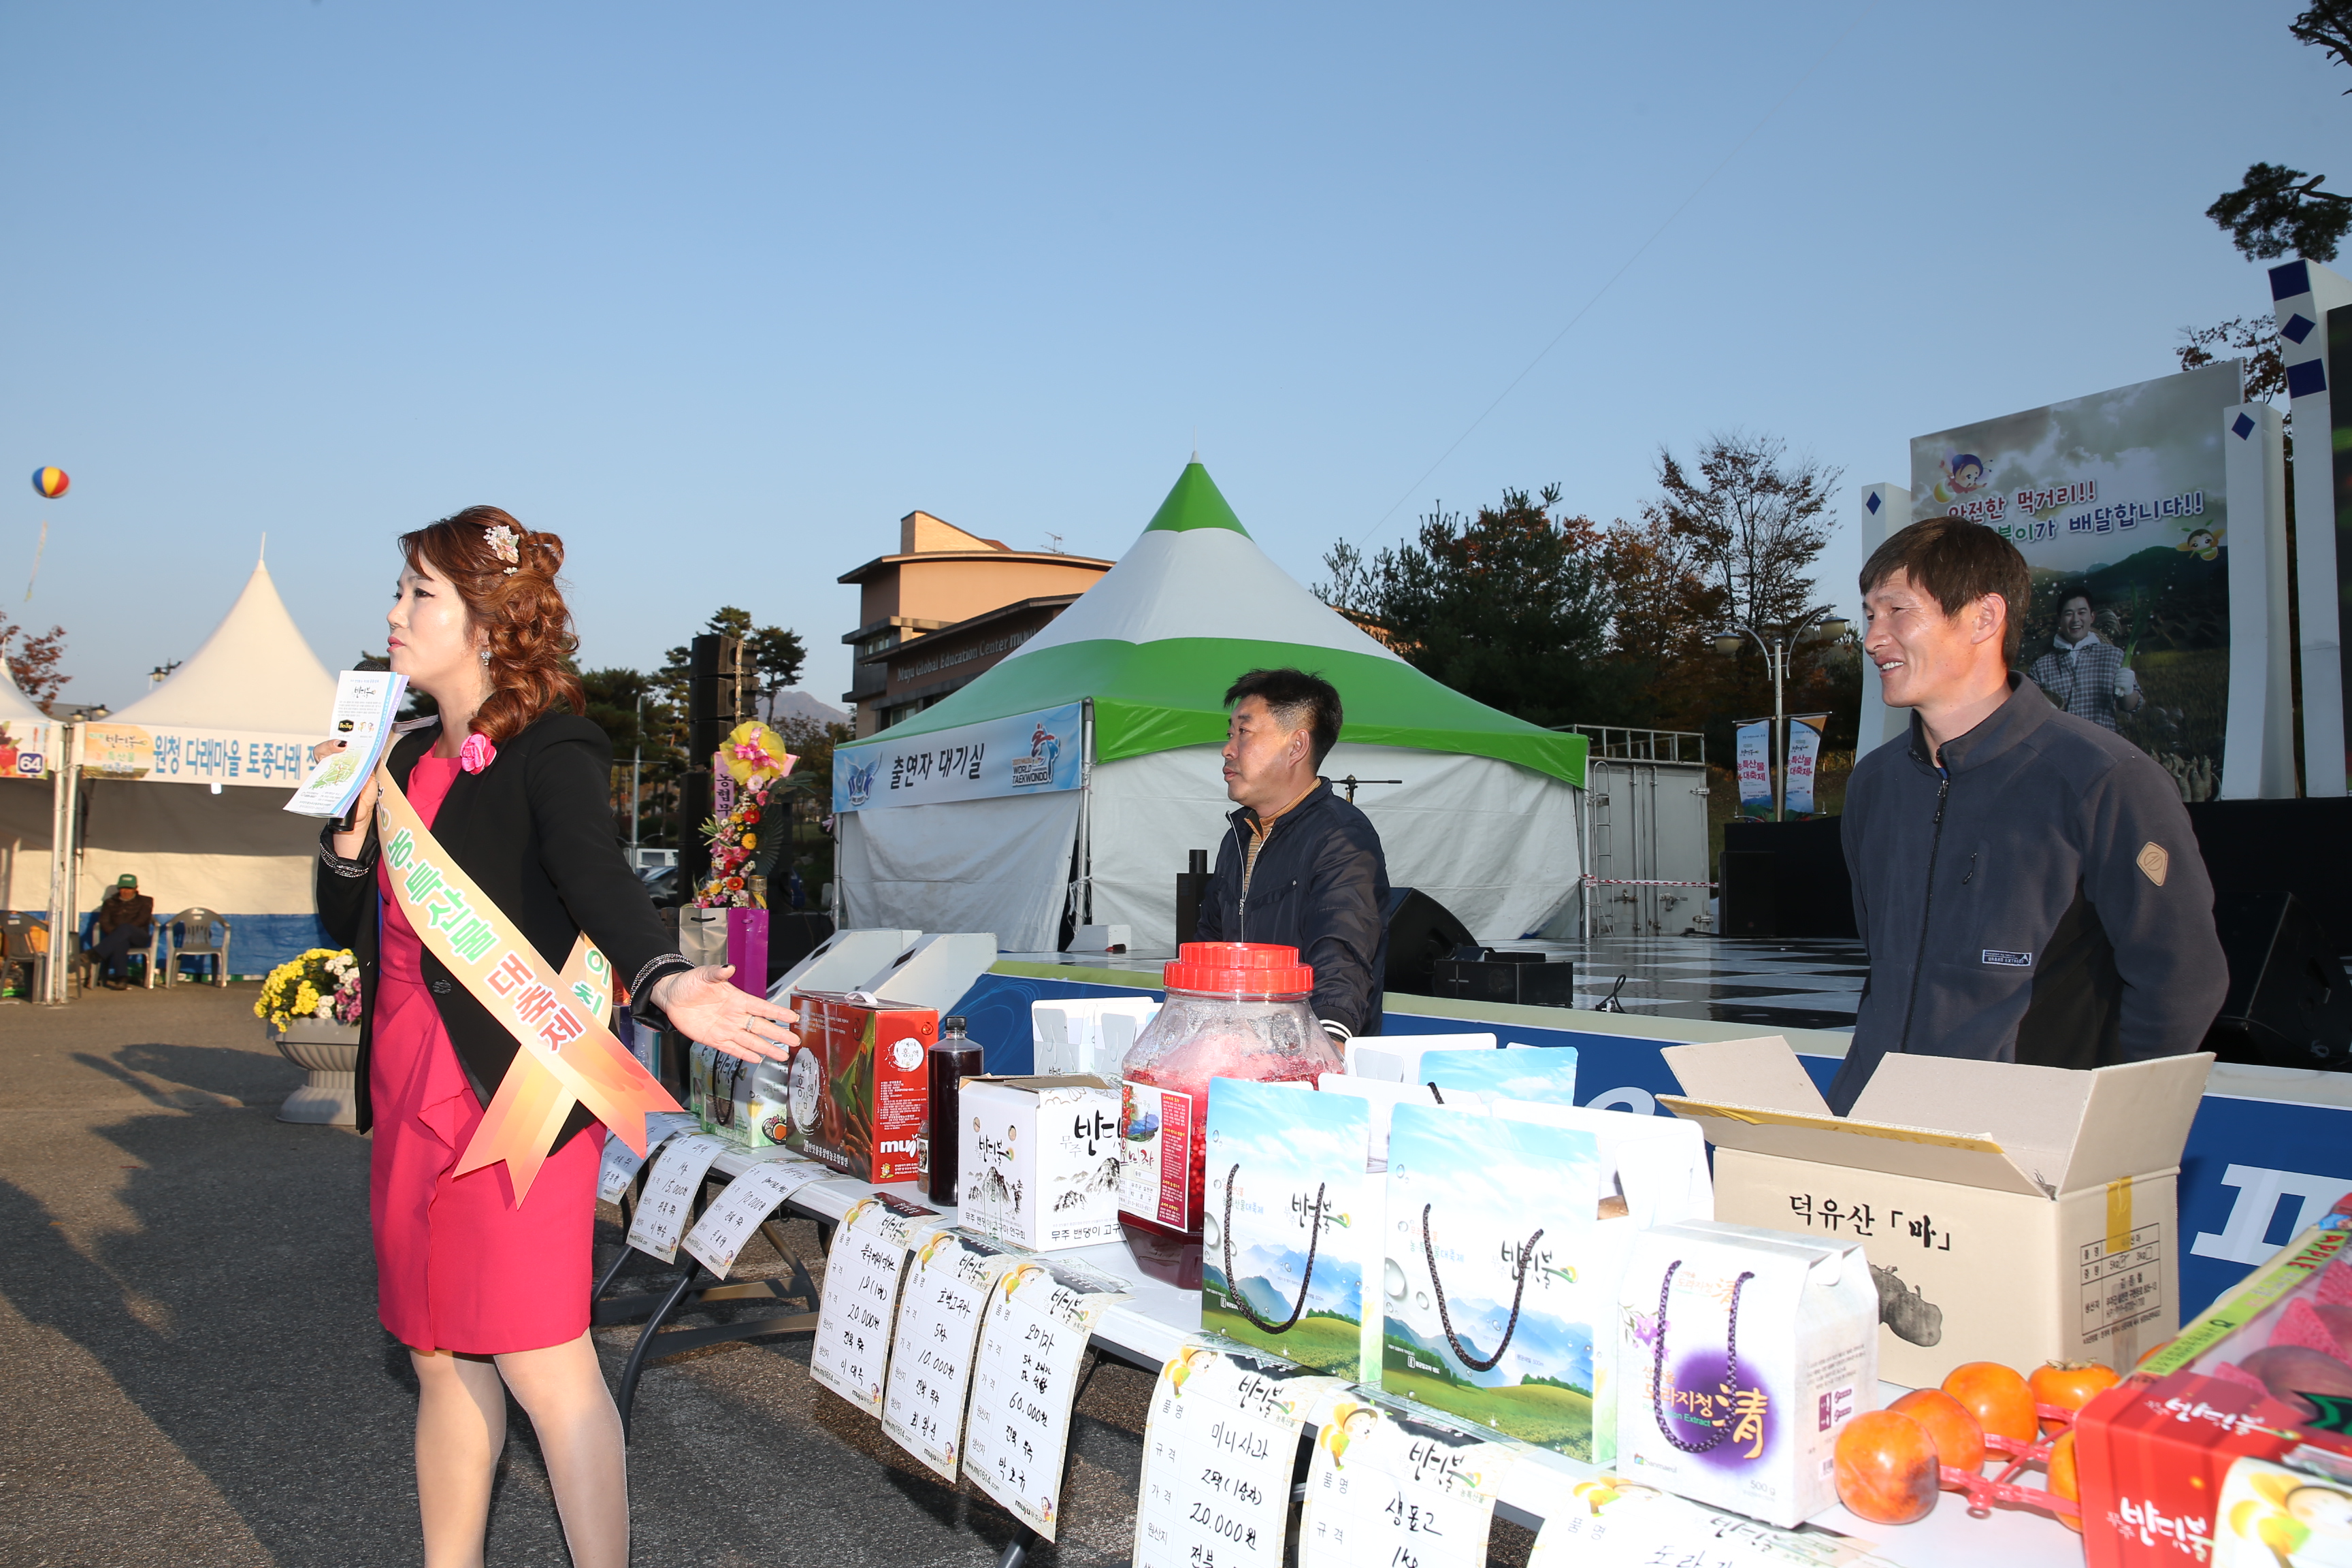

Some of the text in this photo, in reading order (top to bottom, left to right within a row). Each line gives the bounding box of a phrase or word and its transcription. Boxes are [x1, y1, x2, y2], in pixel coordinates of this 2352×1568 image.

[2017, 480, 2096, 513] 먹거리!!
[2068, 491, 2204, 534] 배달합니다!!
[898, 666, 915, 683] Muju
[916, 659, 938, 675] Global
[941, 646, 978, 669] Education
[980, 638, 1009, 656] Center
[19, 755, 42, 771] 64
[153, 735, 181, 774] 원청
[185, 737, 242, 777] 다래마을
[246, 742, 301, 780] 토종다래
[890, 751, 934, 789] 출연자
[938, 743, 985, 780] 대기실
[1013, 765, 1032, 774] WORLD
[1013, 772, 1047, 784] TAEKWONDO
[1744, 772, 1765, 781] 대축제
[1790, 766, 1810, 777] 대축제
[486, 952, 584, 1052] 대축제
[1789, 1194, 1875, 1236] 덕유산
[1010, 1226, 1026, 1241] 연구회
[1051, 1230, 1070, 1241] 무주
[1103, 1223, 1120, 1235] 고구
[2285, 1235, 2345, 1271] APPLE
[823, 1318, 834, 1333] 원산지
[1025, 1324, 1054, 1356] 오미자
[819, 1345, 830, 1360] 생산자
[895, 1366, 906, 1383] 원산지
[890, 1396, 902, 1413] 생산자
[977, 1405, 991, 1424] 원산지
[1683, 1414, 1712, 1428] Extract
[972, 1437, 985, 1456] 생산자
[1211, 1421, 1269, 1460] 미니사과
[1015, 1499, 1030, 1516] muju
[1147, 1522, 1168, 1546] 원산지
